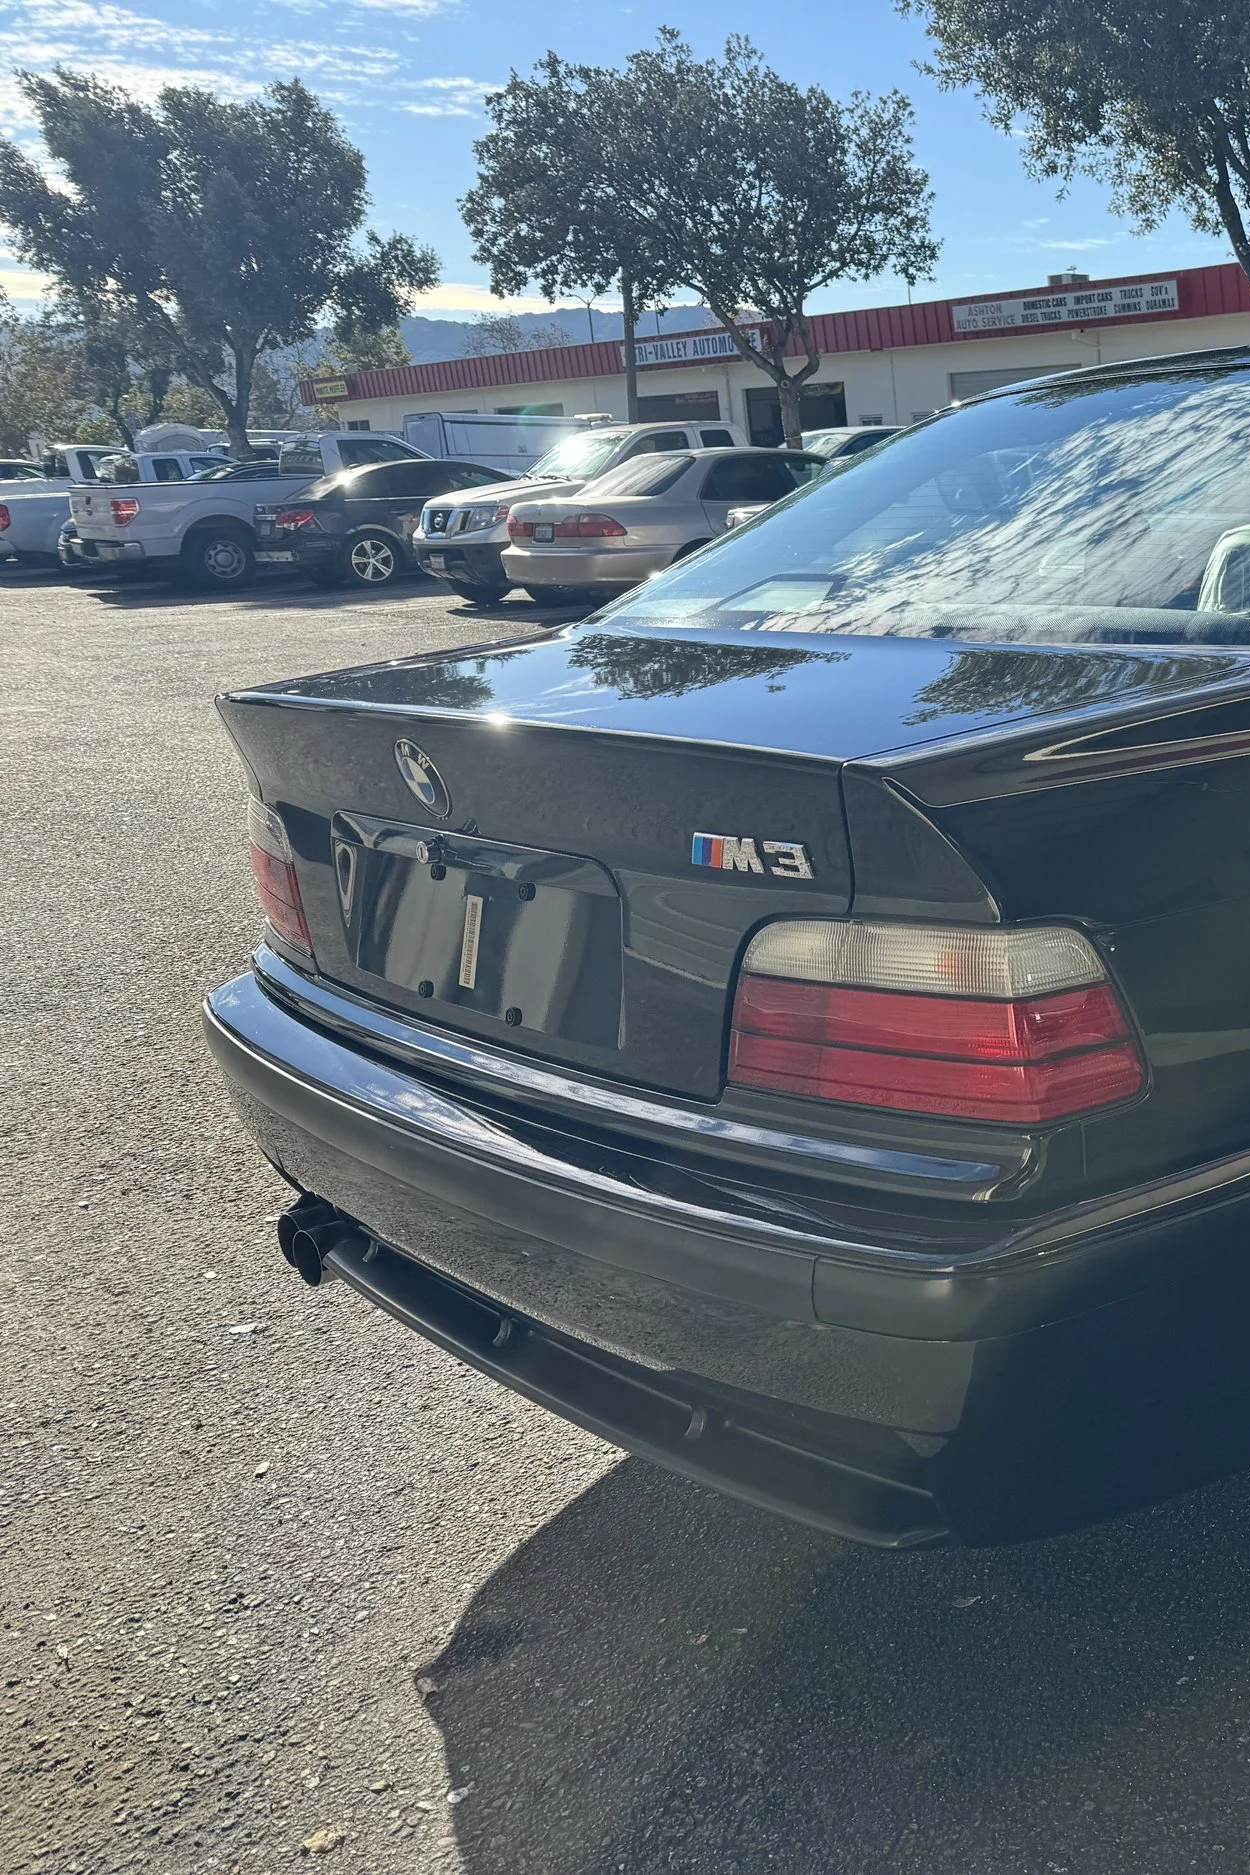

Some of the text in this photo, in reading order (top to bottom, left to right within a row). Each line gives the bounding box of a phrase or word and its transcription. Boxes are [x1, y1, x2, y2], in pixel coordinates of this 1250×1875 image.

[967, 303, 1003, 317] ASHTON
[956, 314, 1016, 330] AUTO SERVICE
[721, 836, 815, 879] M3
